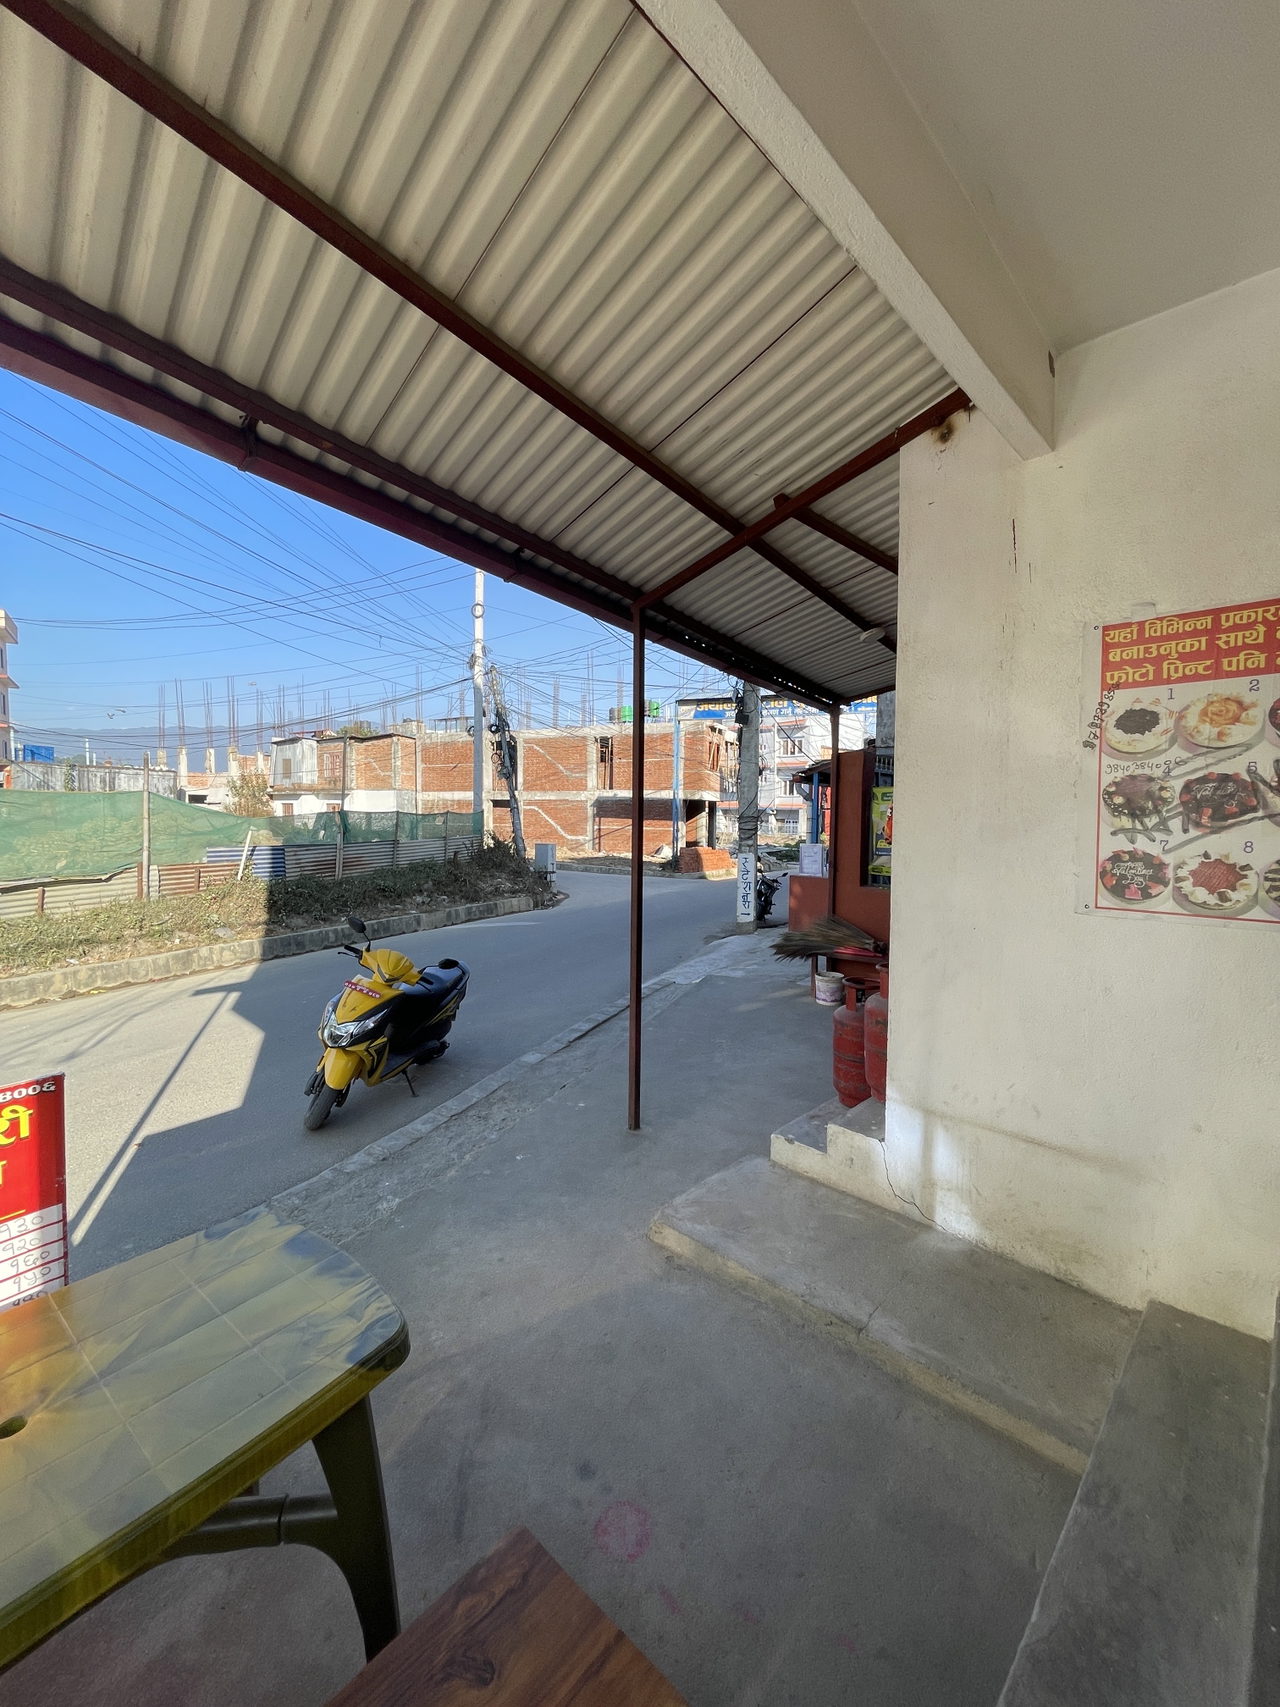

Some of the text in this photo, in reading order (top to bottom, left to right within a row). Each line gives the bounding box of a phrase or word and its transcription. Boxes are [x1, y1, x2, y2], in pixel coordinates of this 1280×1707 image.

[1144, 617, 1214, 638] विभिन्न
[1220, 605, 1280, 629] प्रकार
[1108, 637, 1208, 662] बनाउनुका
[1104, 663, 1156, 684] फोटो
[1162, 660, 1215, 680] प्रिन्ट
[1221, 650, 1268, 671] पनि
[1249, 679, 1260, 692] 2
[1166, 688, 1176, 700] 1
[1248, 761, 1258, 774] 5
[1159, 840, 1169, 852] 7
[1244, 841, 1254, 853] 8
